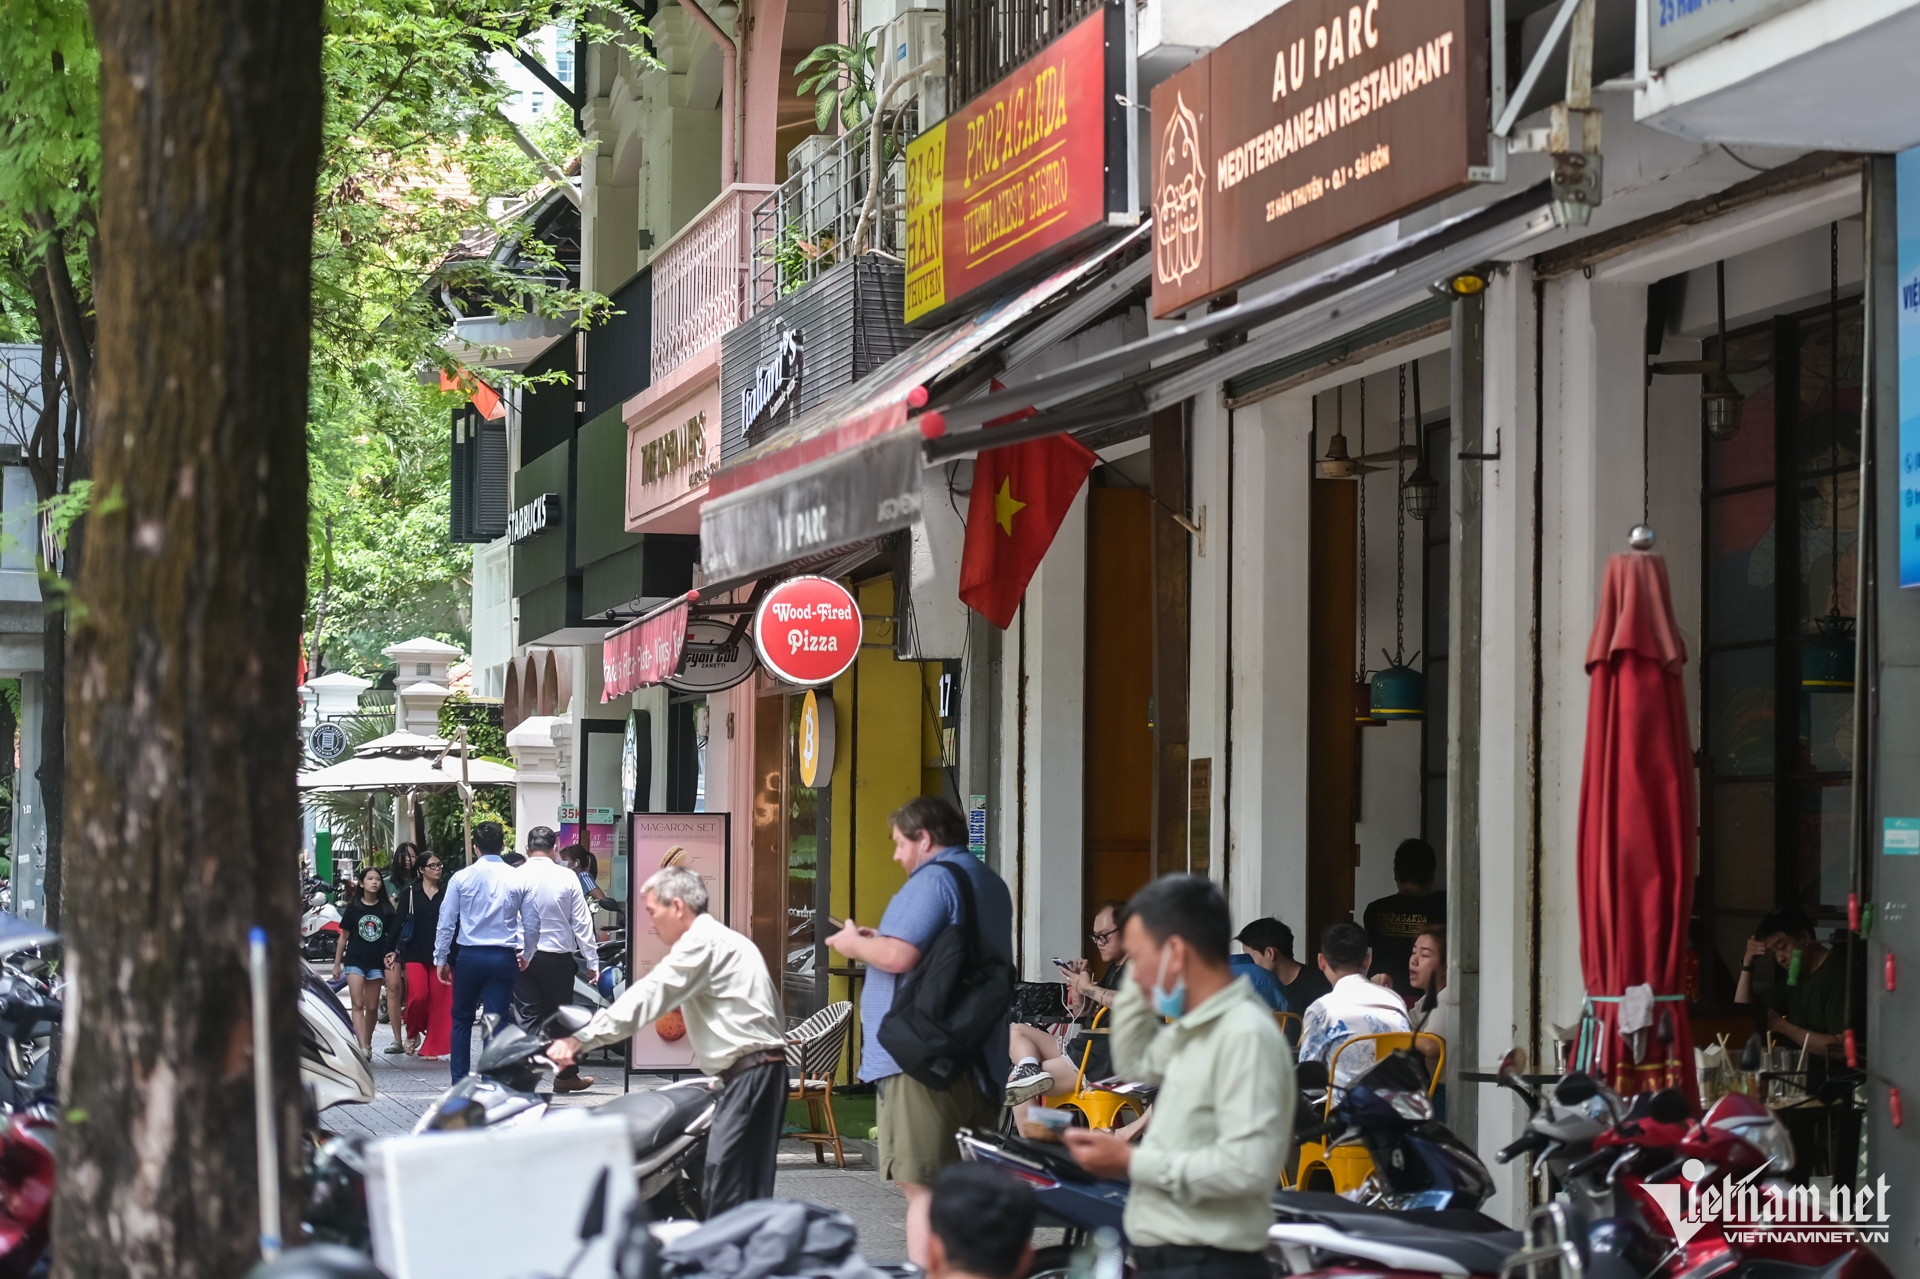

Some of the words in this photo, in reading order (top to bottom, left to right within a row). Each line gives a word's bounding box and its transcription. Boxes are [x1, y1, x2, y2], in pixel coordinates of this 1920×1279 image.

[1272, 38, 1305, 103] AU
[1314, 0, 1378, 78] PARC
[963, 57, 1067, 189] PROPAGANDA
[1217, 94, 1337, 193] MEDITERRANEAN
[1339, 31, 1453, 127] RESTAURANT
[963, 181, 1025, 256] VIETNAMESE
[1029, 156, 1068, 221] BISTRO
[906, 203, 941, 278] HAN
[1903, 277, 1920, 313] VIỆ
[507, 493, 547, 546] STARBUCKS
[772, 603, 852, 622] Wood-Fired
[787, 628, 838, 656] Pizza
[939, 673, 952, 718] 17
[640, 823, 693, 832] MACARON
[697, 823, 717, 832] SET
